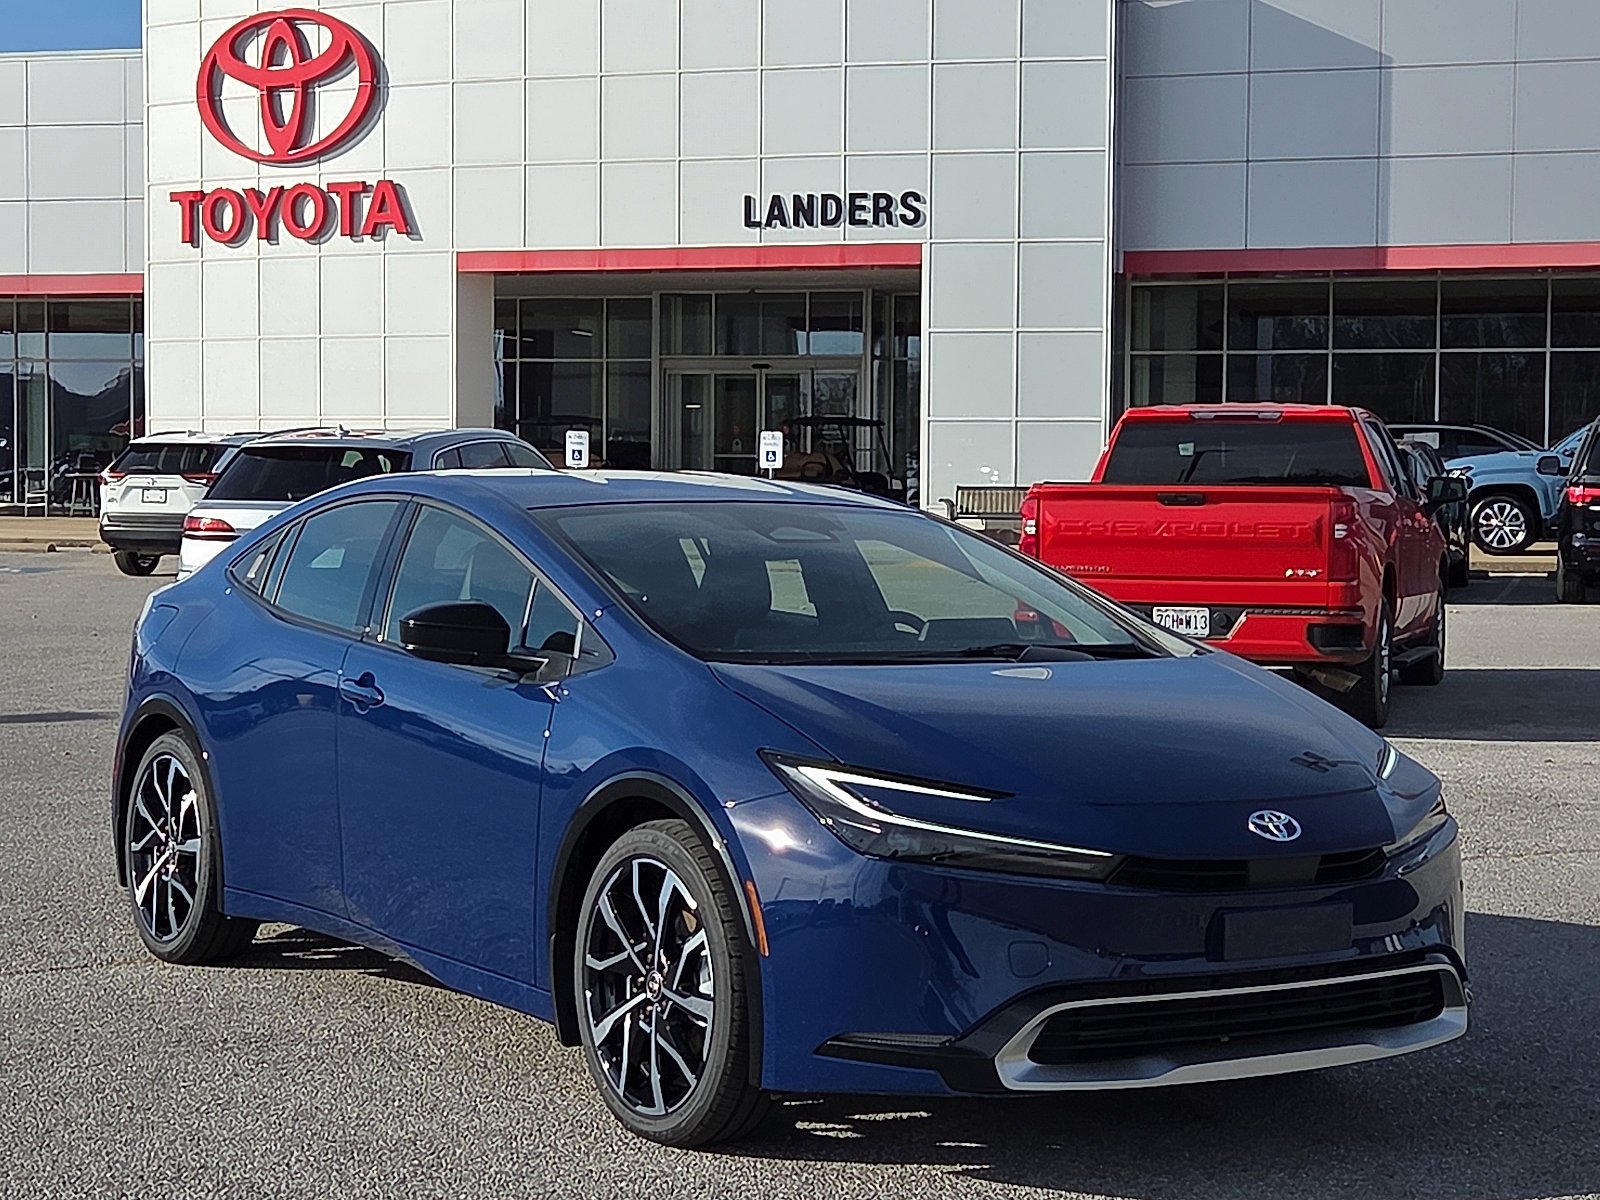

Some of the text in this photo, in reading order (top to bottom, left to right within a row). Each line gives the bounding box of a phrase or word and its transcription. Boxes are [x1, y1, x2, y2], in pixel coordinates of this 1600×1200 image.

[170, 180, 413, 245] TOYOTA
[744, 191, 924, 228] LANDERS
[1057, 519, 1310, 539] CHEVROLET
